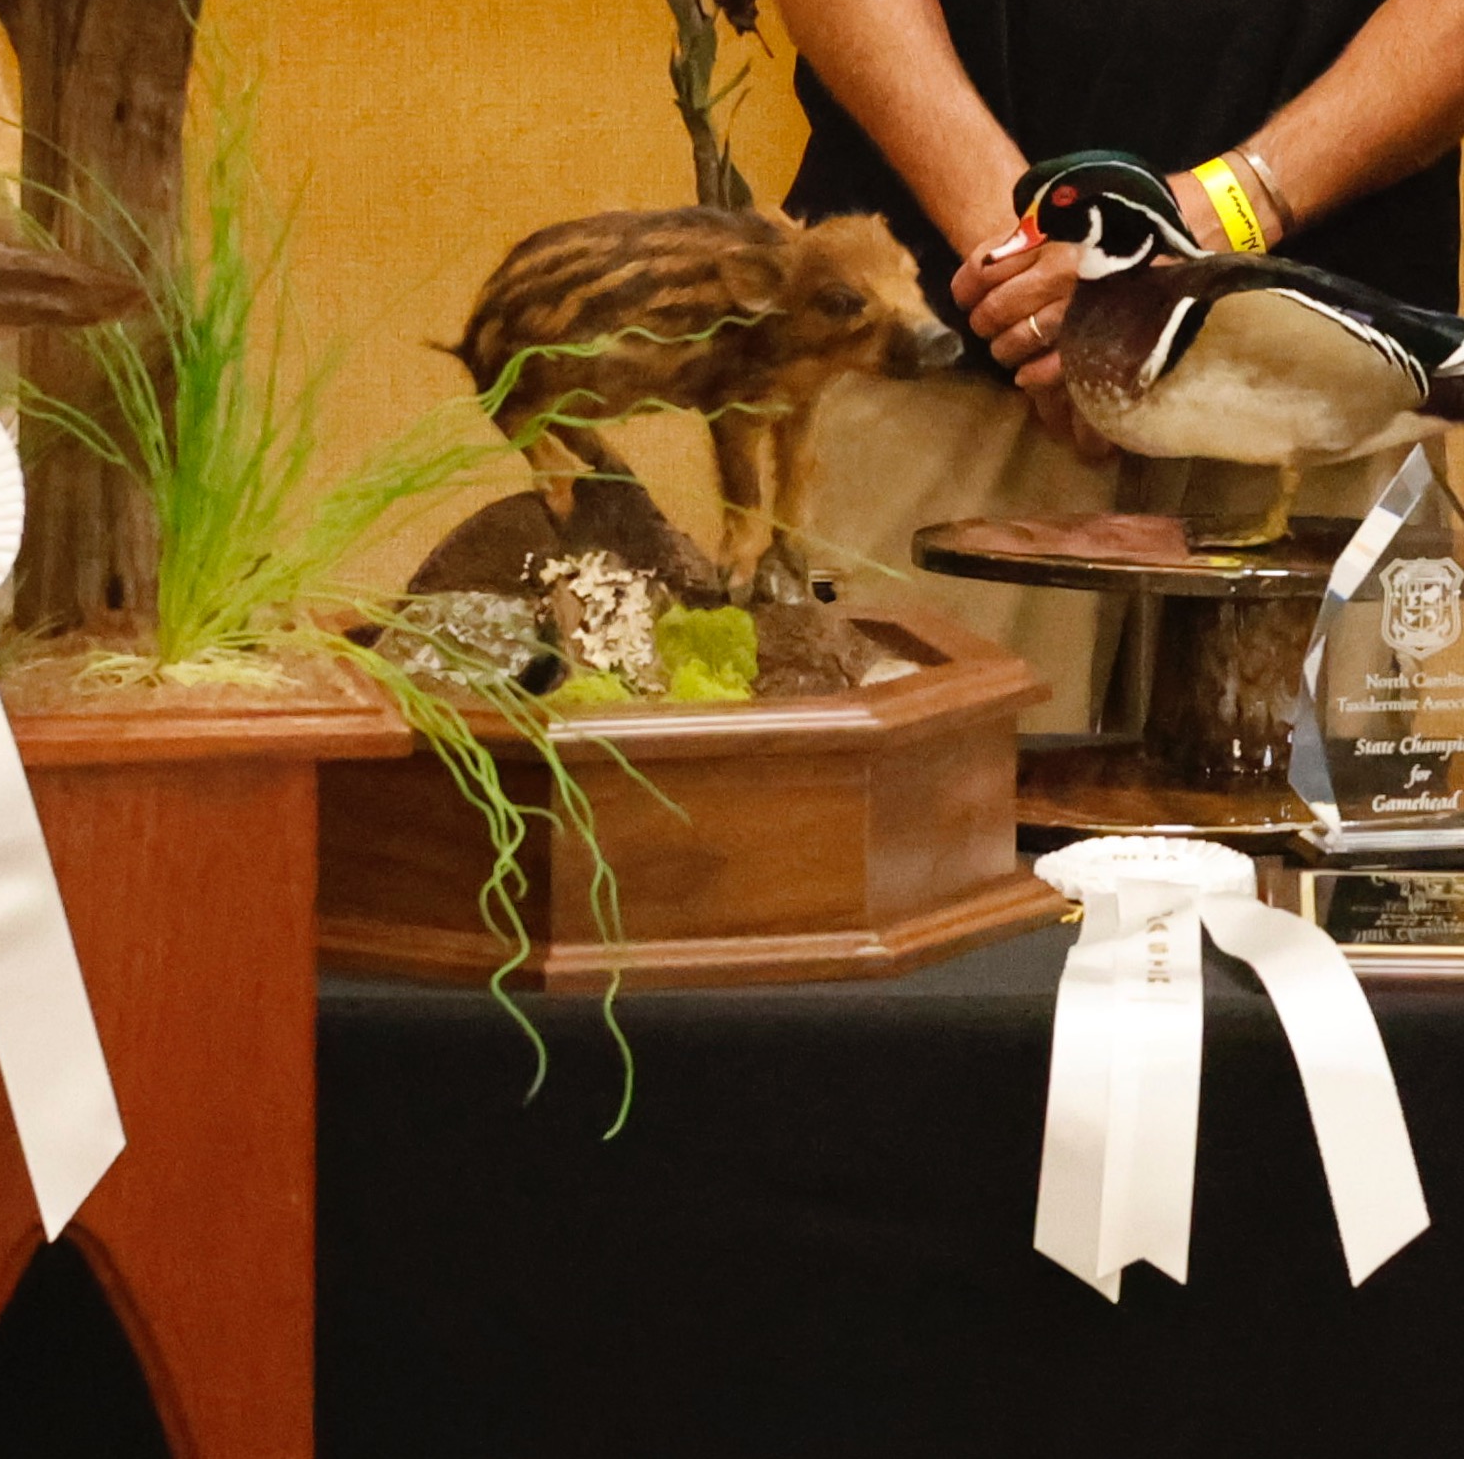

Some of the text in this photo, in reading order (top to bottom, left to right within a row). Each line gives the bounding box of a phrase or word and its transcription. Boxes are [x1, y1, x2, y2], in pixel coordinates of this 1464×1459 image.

[1365, 672, 1409, 690] North
[1354, 737, 1396, 756] State
[1404, 764, 1432, 788] for
[1372, 790, 1461, 813] Gamehead
